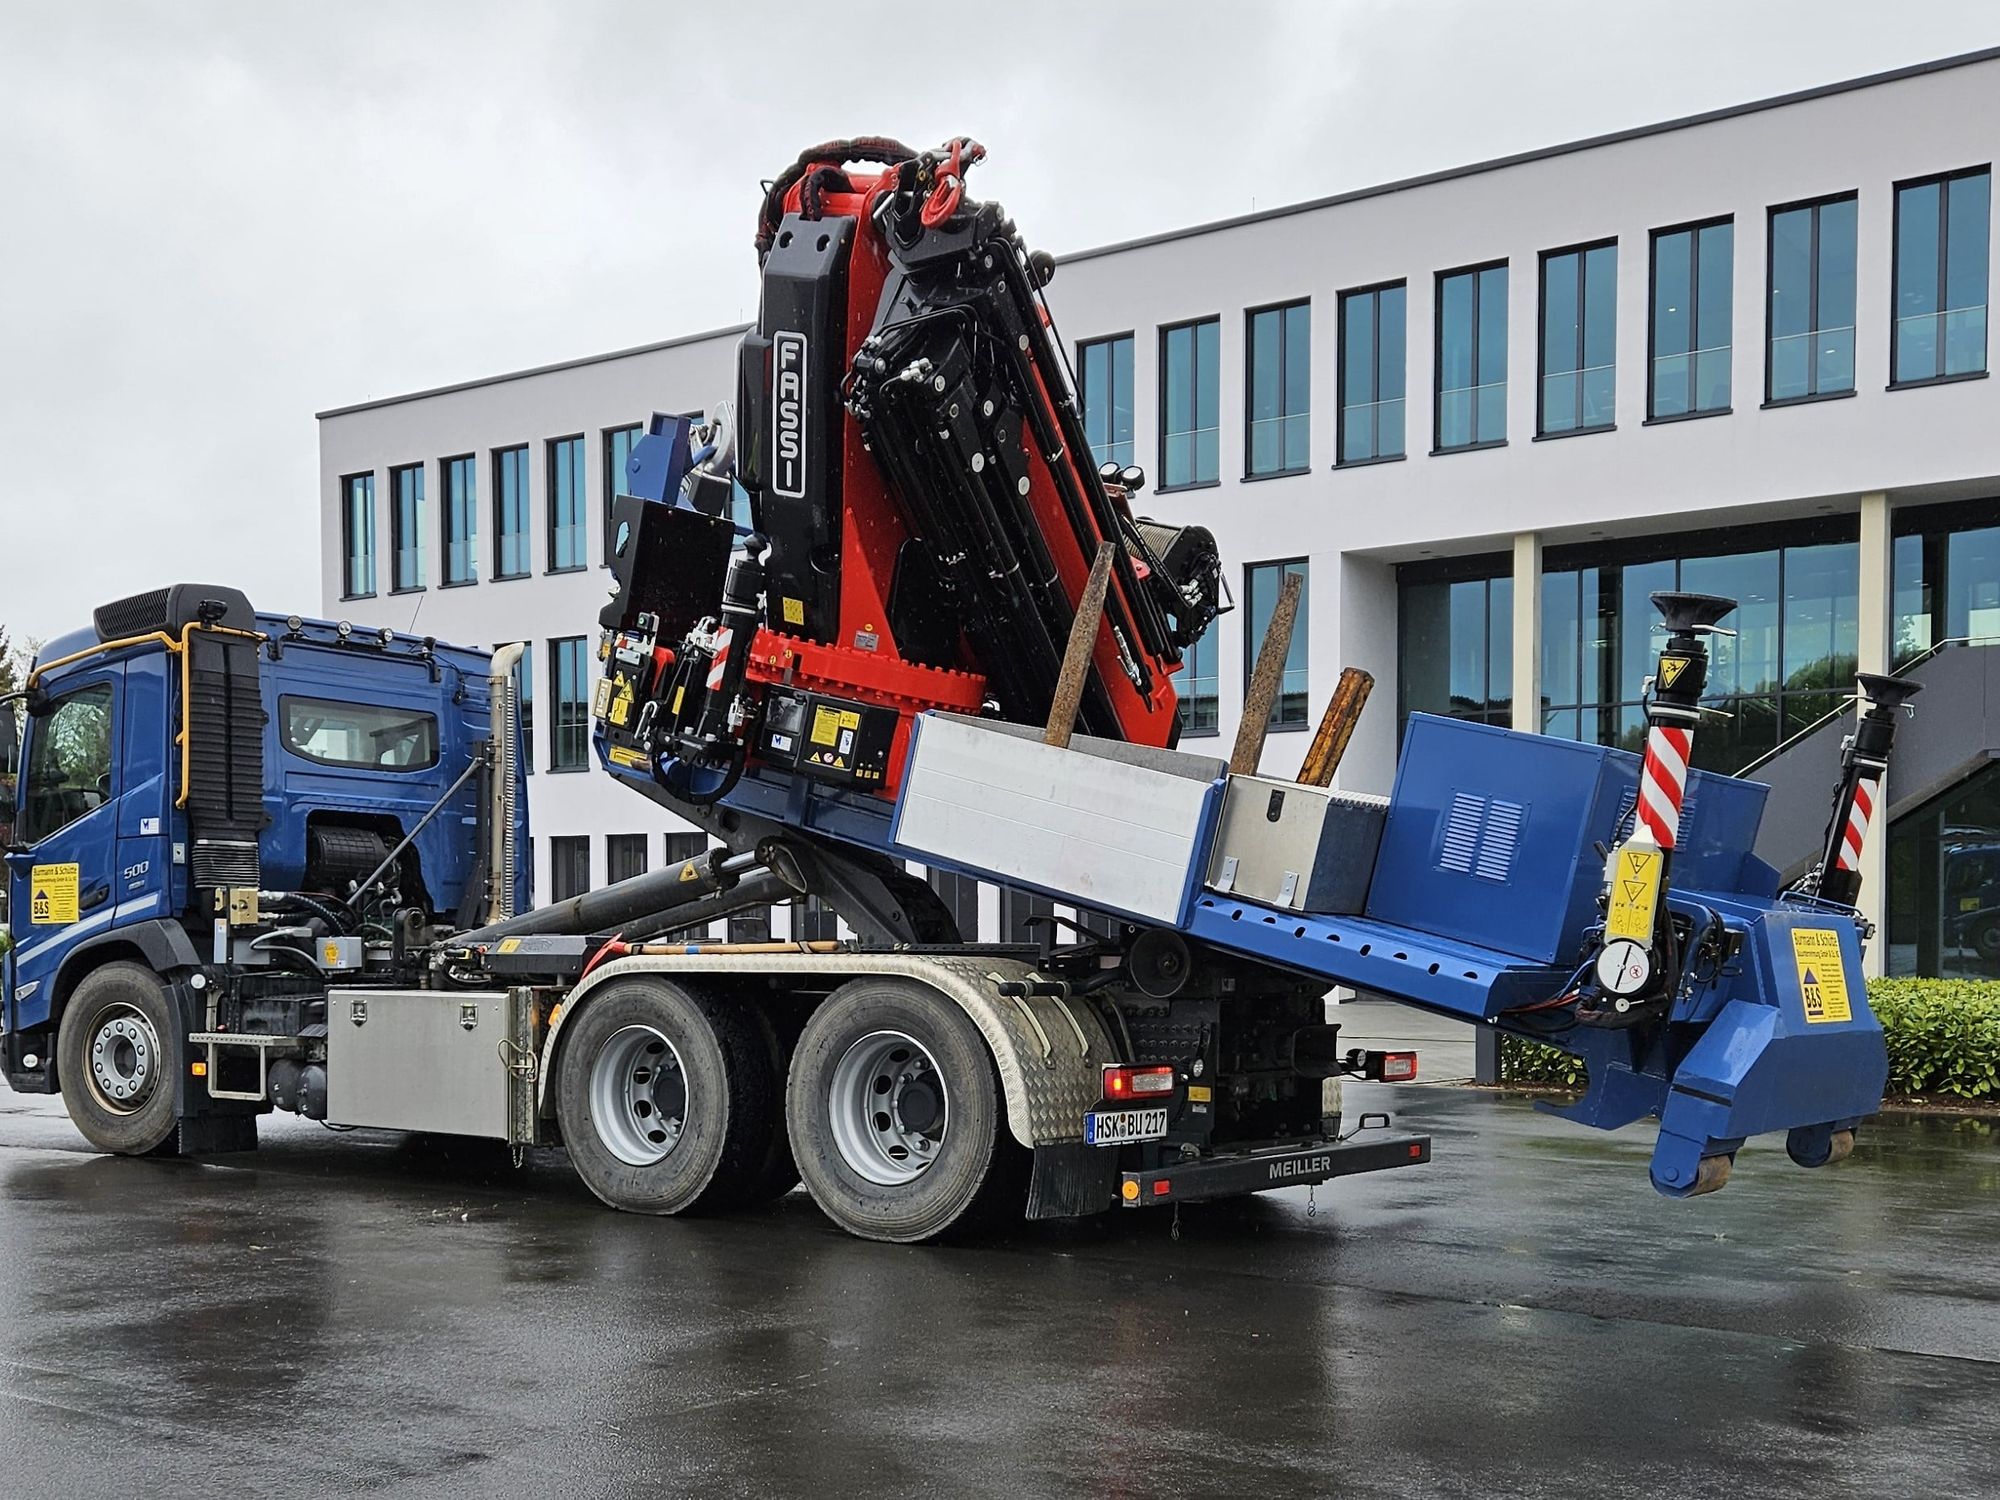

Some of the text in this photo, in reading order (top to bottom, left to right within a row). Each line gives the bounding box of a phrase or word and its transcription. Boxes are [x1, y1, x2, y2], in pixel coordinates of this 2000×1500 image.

[781, 342, 799, 487] FASSI
[124, 861, 149, 879] 500
[34, 901, 49, 914] B&S
[1804, 986, 1822, 1009] B&S
[1096, 1111, 1165, 1139] HSK BU 217
[1269, 1156, 1331, 1179] MEILLER
